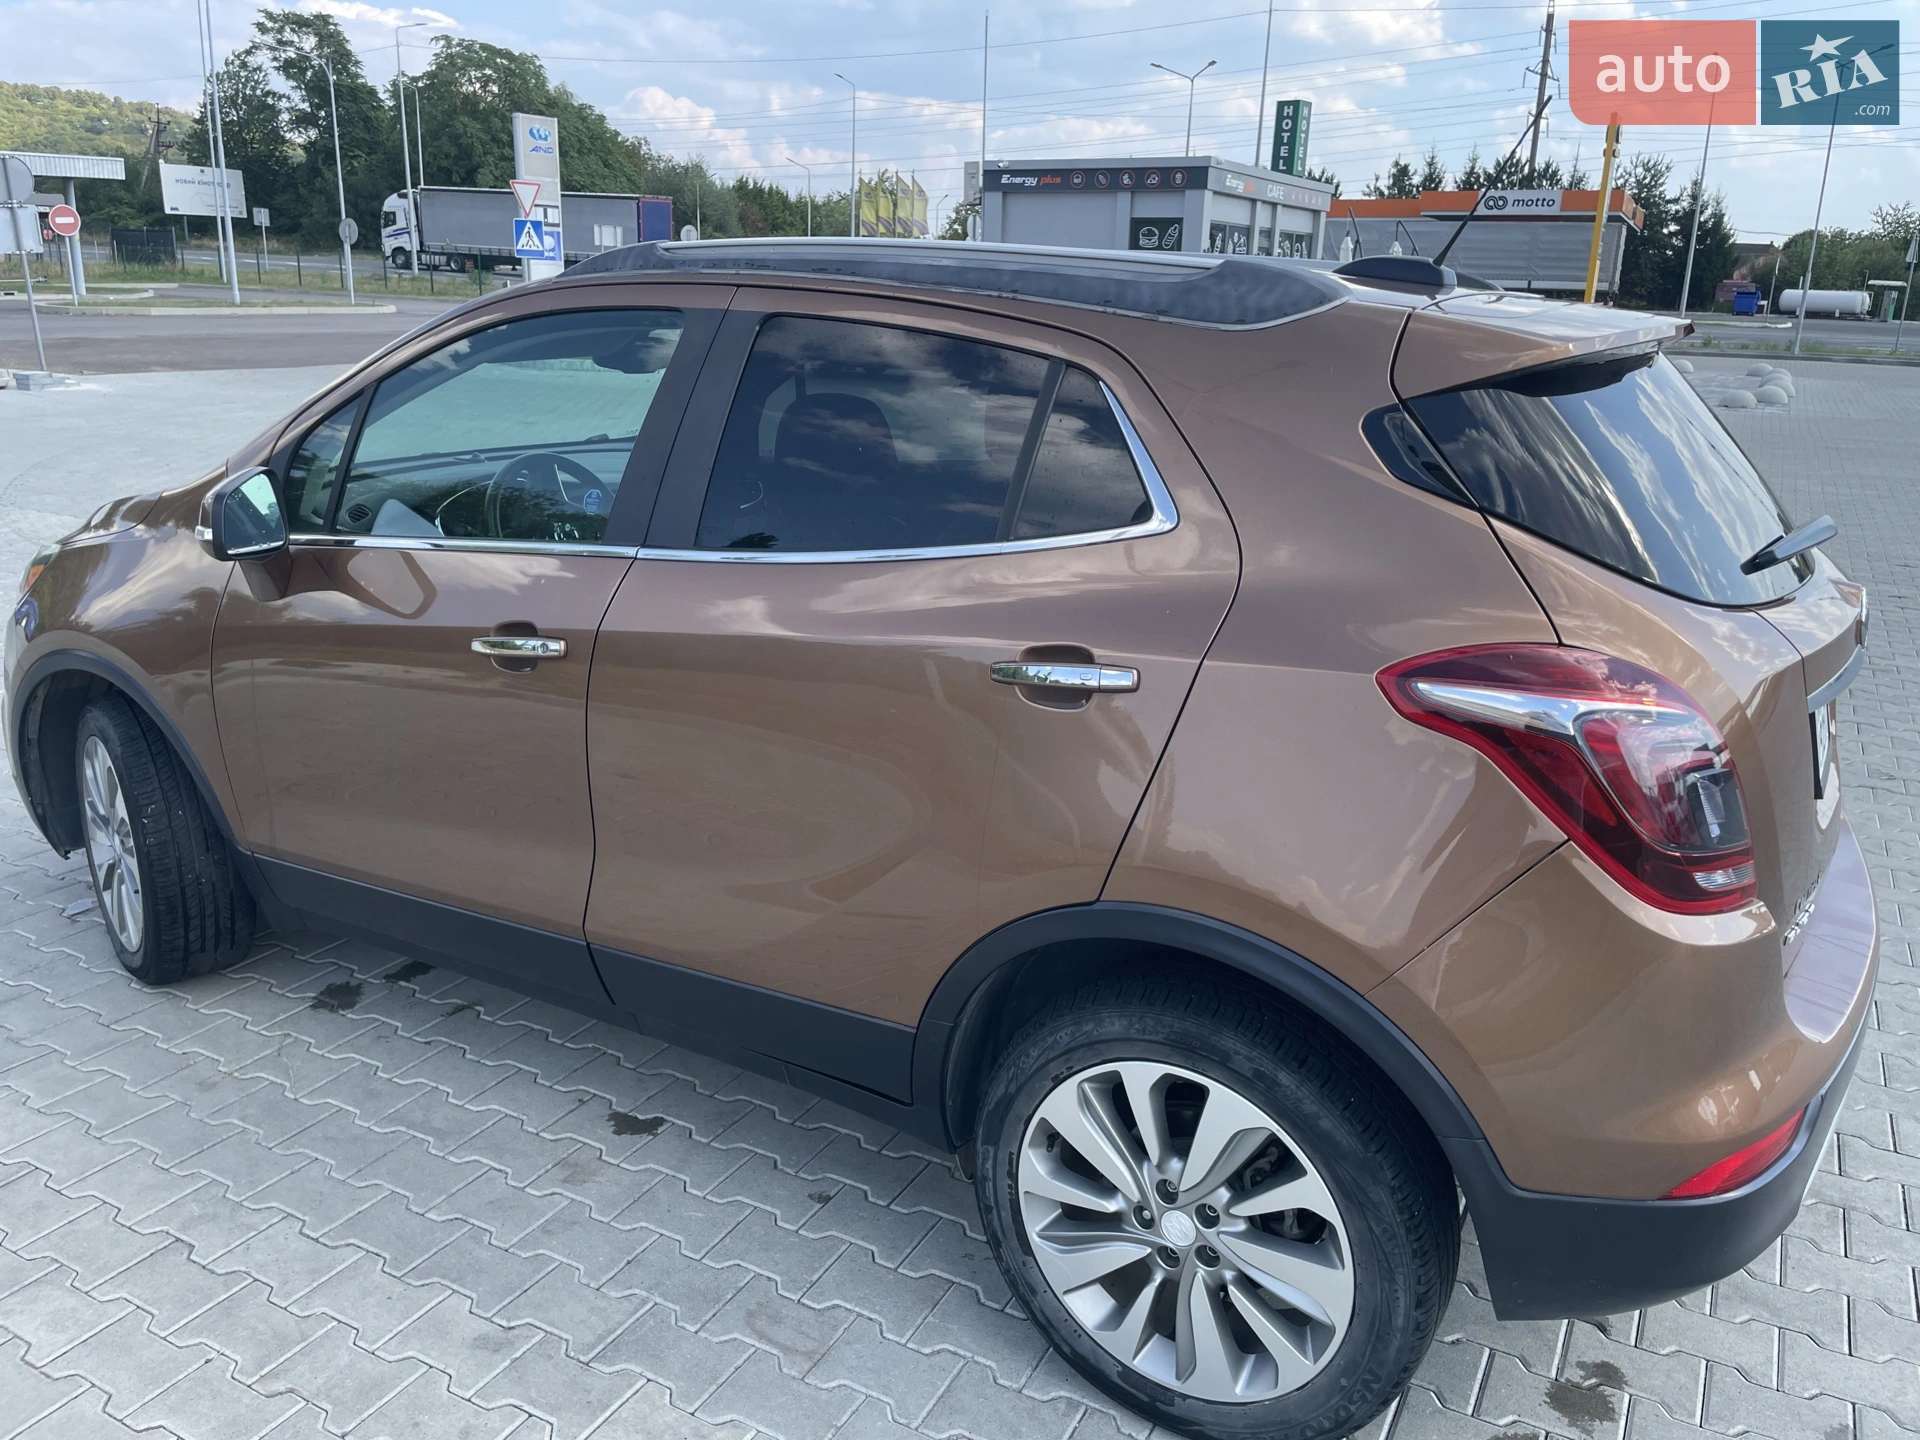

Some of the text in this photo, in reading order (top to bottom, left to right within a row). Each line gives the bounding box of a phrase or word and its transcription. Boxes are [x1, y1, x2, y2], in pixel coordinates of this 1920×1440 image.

[1278, 105, 1294, 170] HOTEL
[1297, 106, 1309, 171] HOTEL
[1000, 174, 1062, 187] Energy plus
[1267, 184, 1285, 200] CAFE
[1511, 197, 1556, 208] motto
